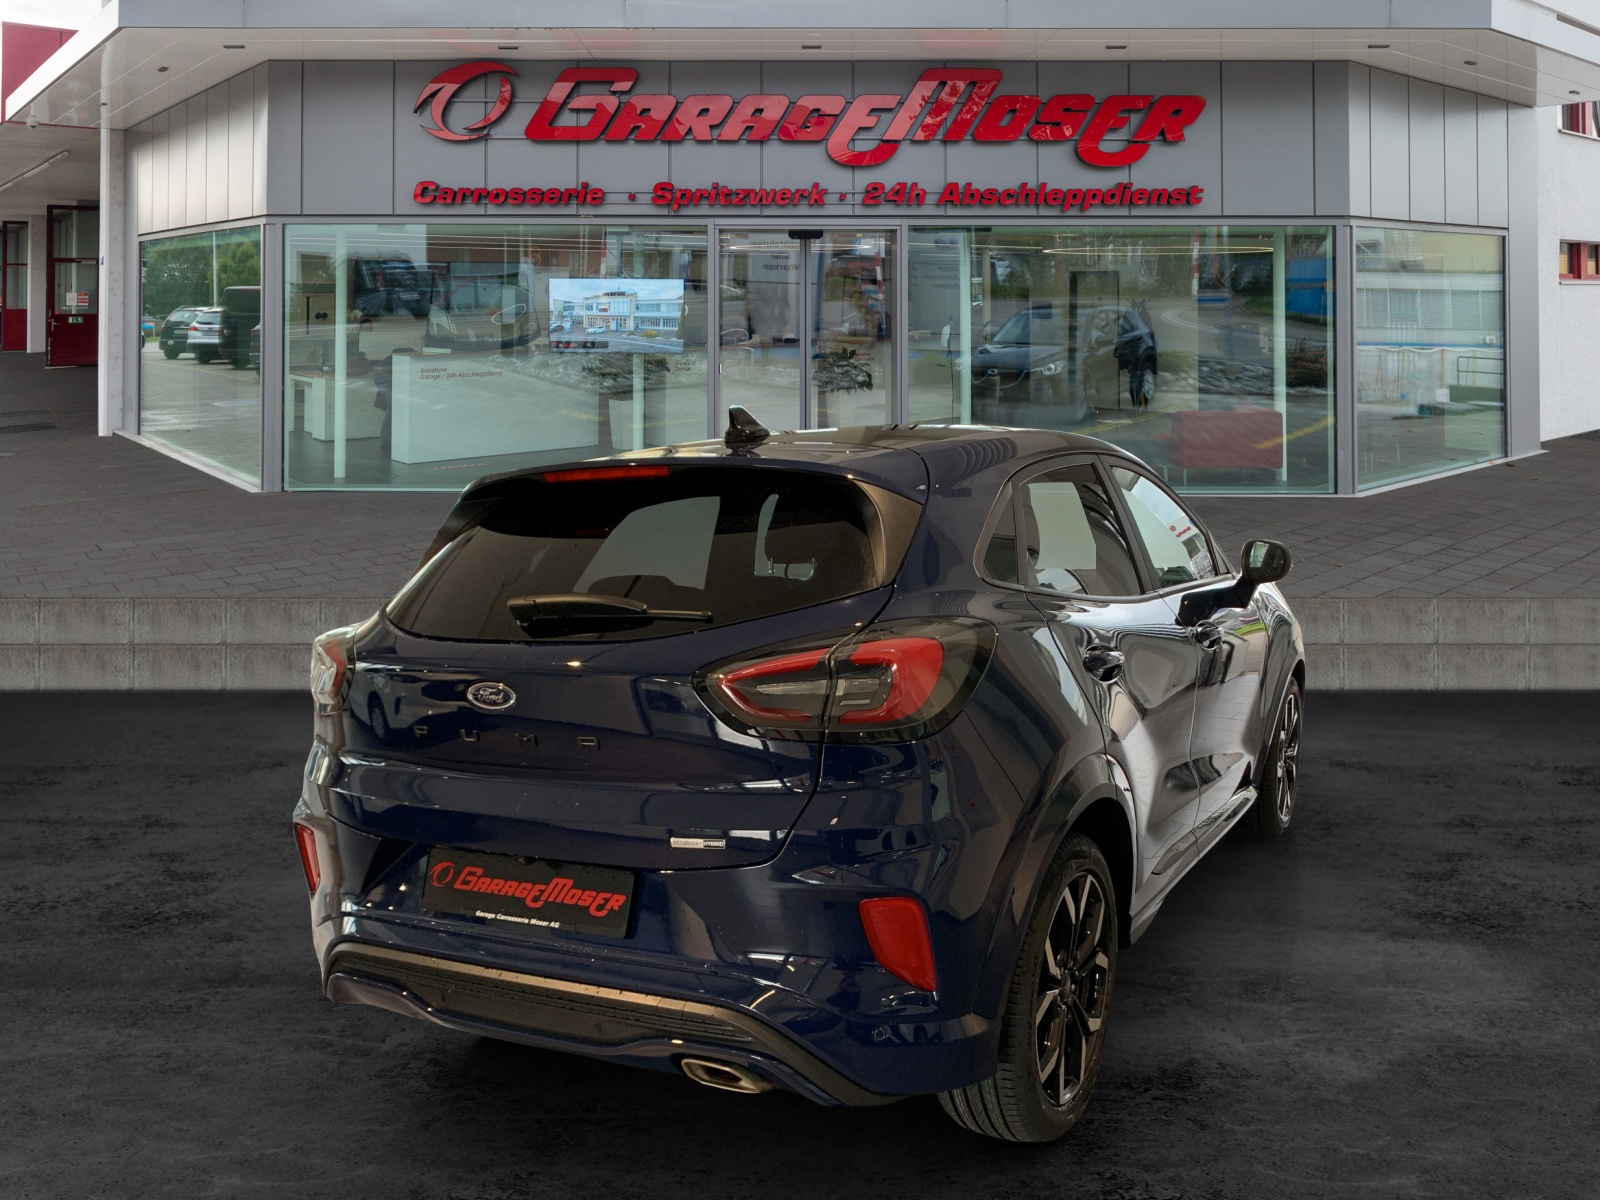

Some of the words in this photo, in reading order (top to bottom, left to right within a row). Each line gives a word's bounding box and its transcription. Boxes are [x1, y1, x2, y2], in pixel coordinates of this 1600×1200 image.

[413, 181, 605, 204] Carrosserie
[651, 182, 828, 212] Spritzwerk
[861, 182, 928, 206] 24h
[937, 182, 1204, 212] Abschleppdienst
[420, 373, 441, 381] Garage
[458, 370, 503, 379] Abschleppdienst
[478, 687, 504, 703] Ford
[703, 840, 724, 848] HYBRID
[475, 910, 495, 919] Garage
[496, 913, 529, 923] Carrosserie
[530, 918, 549, 927] Moser
